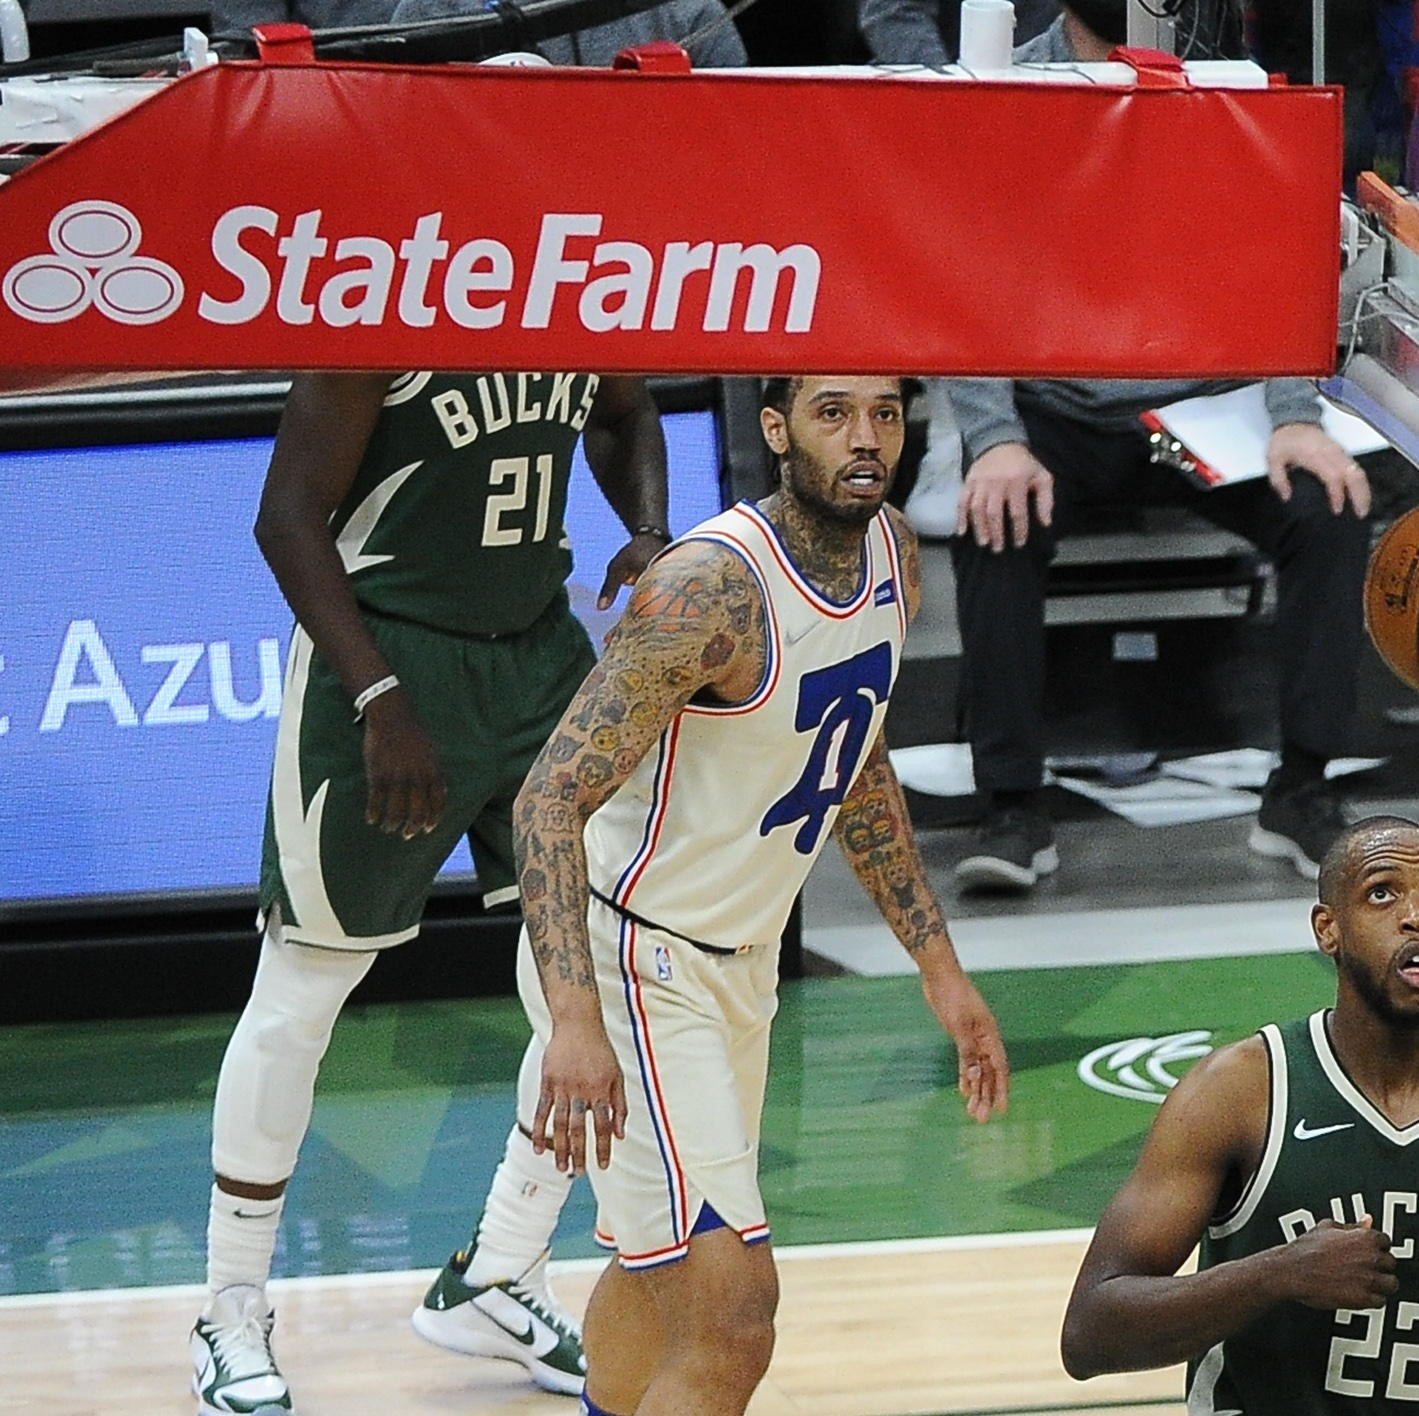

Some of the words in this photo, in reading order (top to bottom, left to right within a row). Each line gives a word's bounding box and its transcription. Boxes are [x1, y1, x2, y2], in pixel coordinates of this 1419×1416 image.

[198, 204, 513, 329] State
[521, 213, 822, 333] Farm
[431, 372, 600, 449] BUCKS
[480, 453, 553, 547] 21
[818, 718, 850, 791] 1
